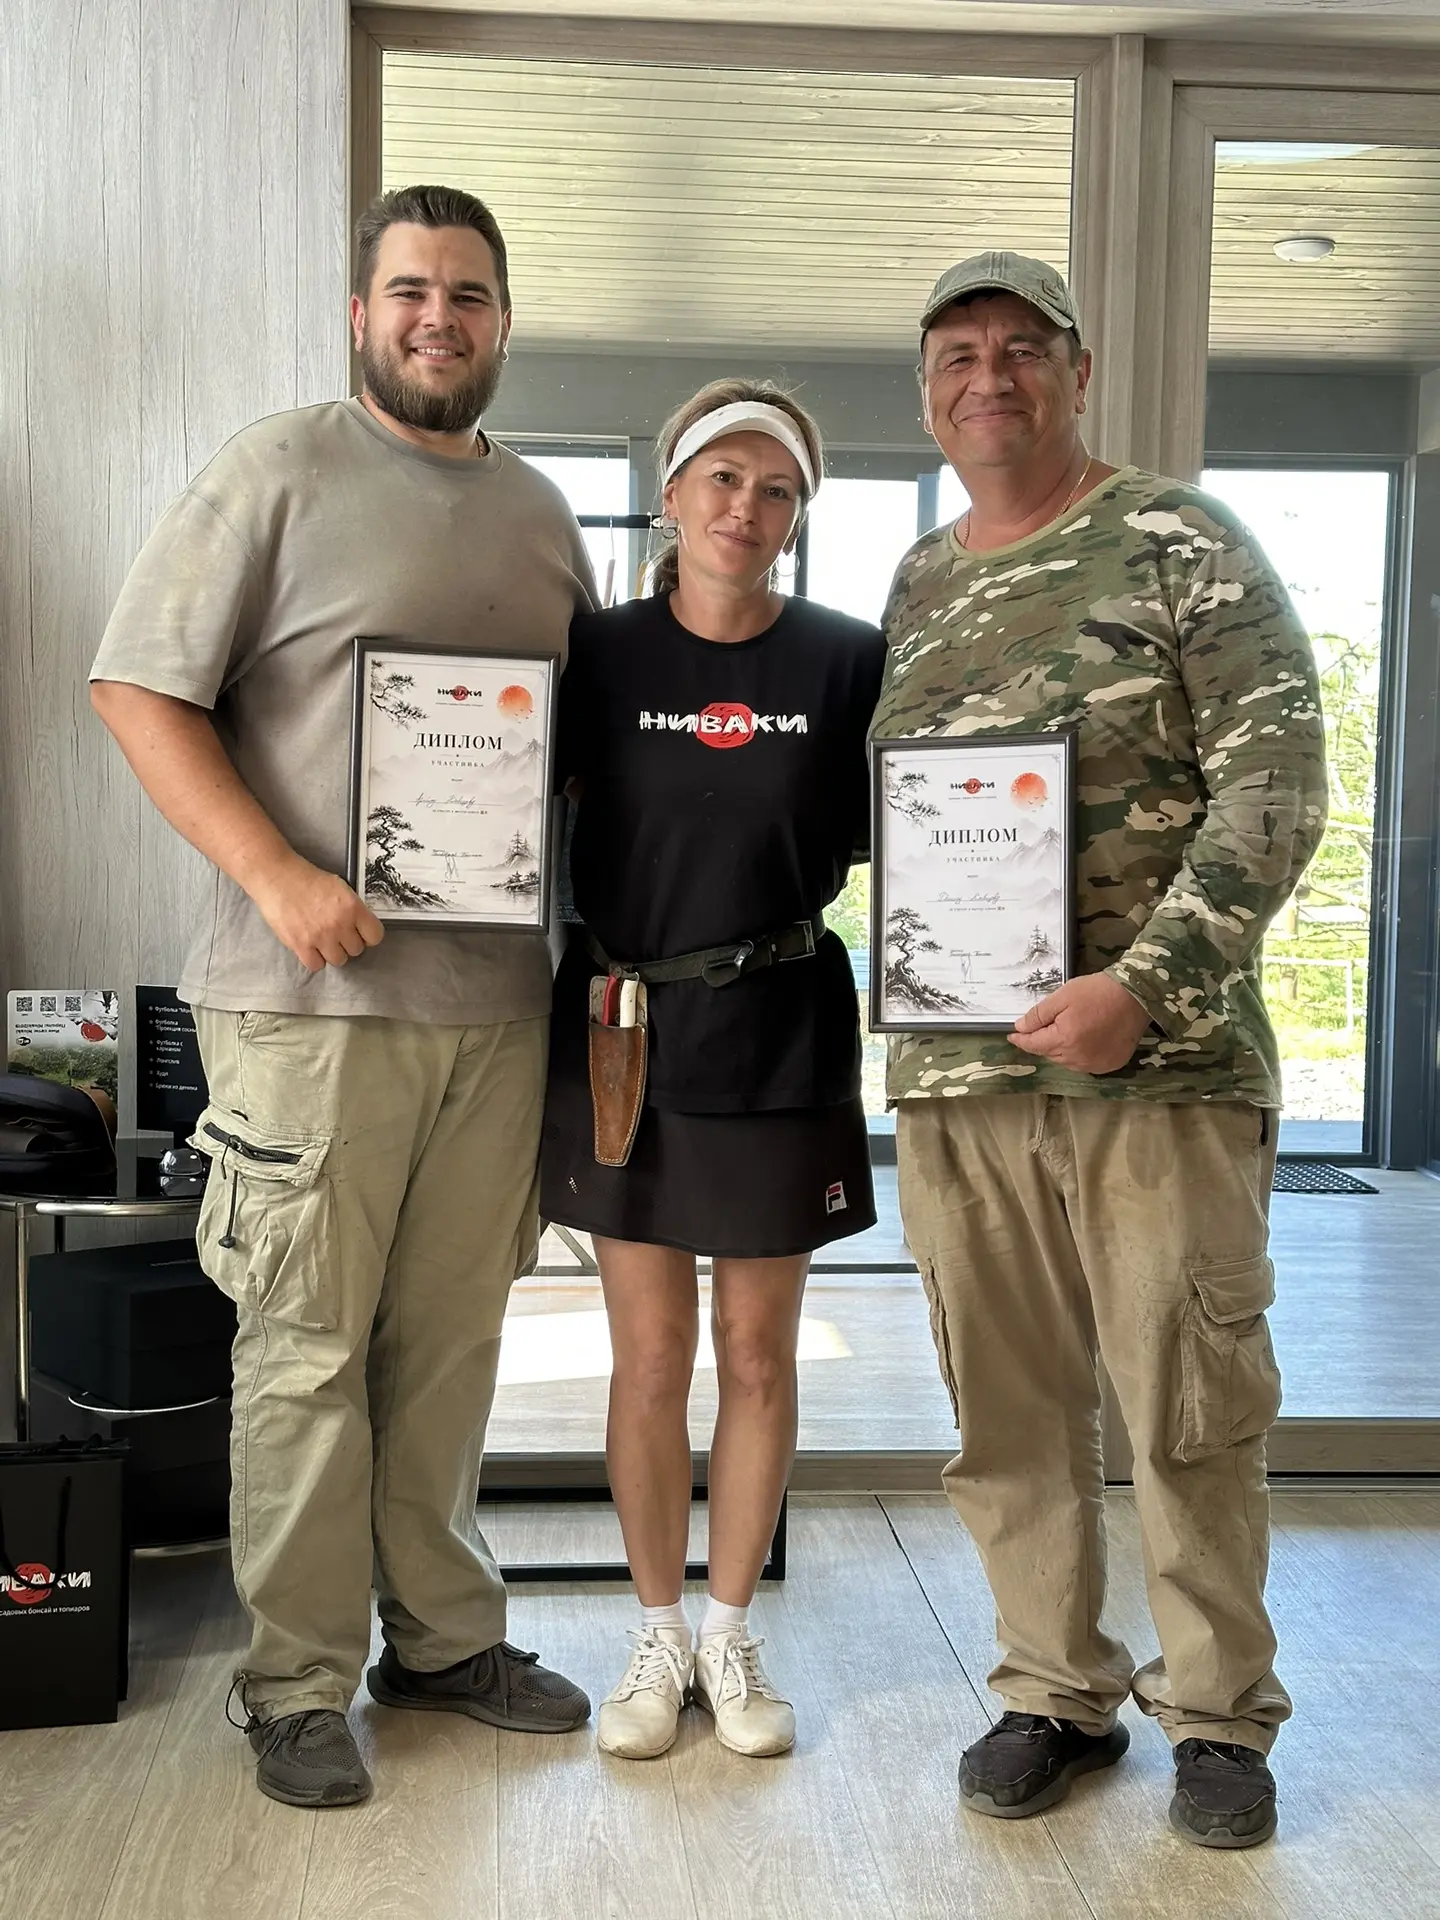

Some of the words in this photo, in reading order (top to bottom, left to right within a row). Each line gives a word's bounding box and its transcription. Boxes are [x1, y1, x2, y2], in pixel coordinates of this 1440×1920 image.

[638, 710, 808, 734] НИВАКИ
[413, 732, 503, 750] ДИПЛОМ
[430, 760, 485, 768] УЧАСТНИКА
[928, 827, 1018, 848] ДИПЛОМ
[946, 856, 1001, 864] УЧАСТНИКА
[28, 1606, 52, 1615] бонсай
[59, 1605, 91, 1613] топиаров
